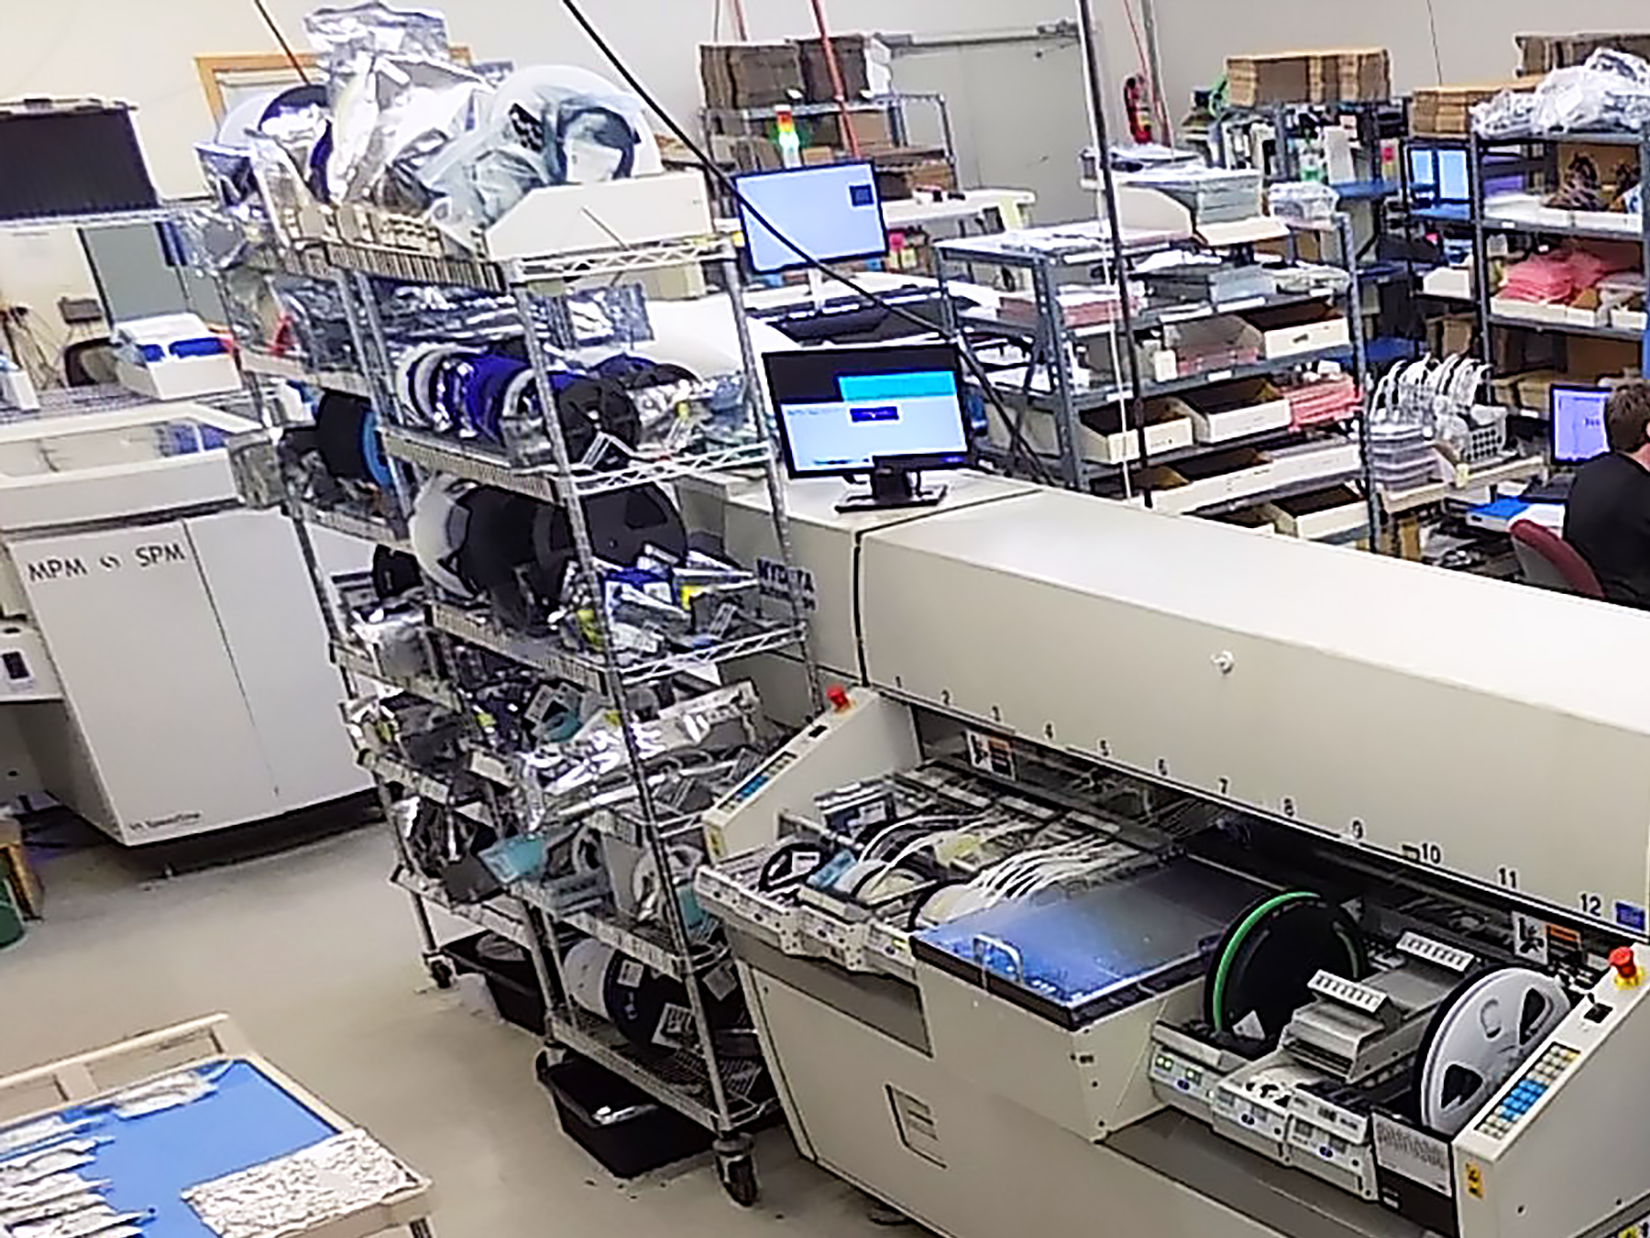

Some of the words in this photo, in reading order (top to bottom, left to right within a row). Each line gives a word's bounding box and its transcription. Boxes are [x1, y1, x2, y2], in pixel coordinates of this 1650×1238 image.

[27, 557, 88, 582] MPM
[134, 542, 186, 568] SPM
[1420, 842, 1441, 864] 10
[1499, 867, 1517, 888] 11
[1580, 892, 1601, 917] 12
